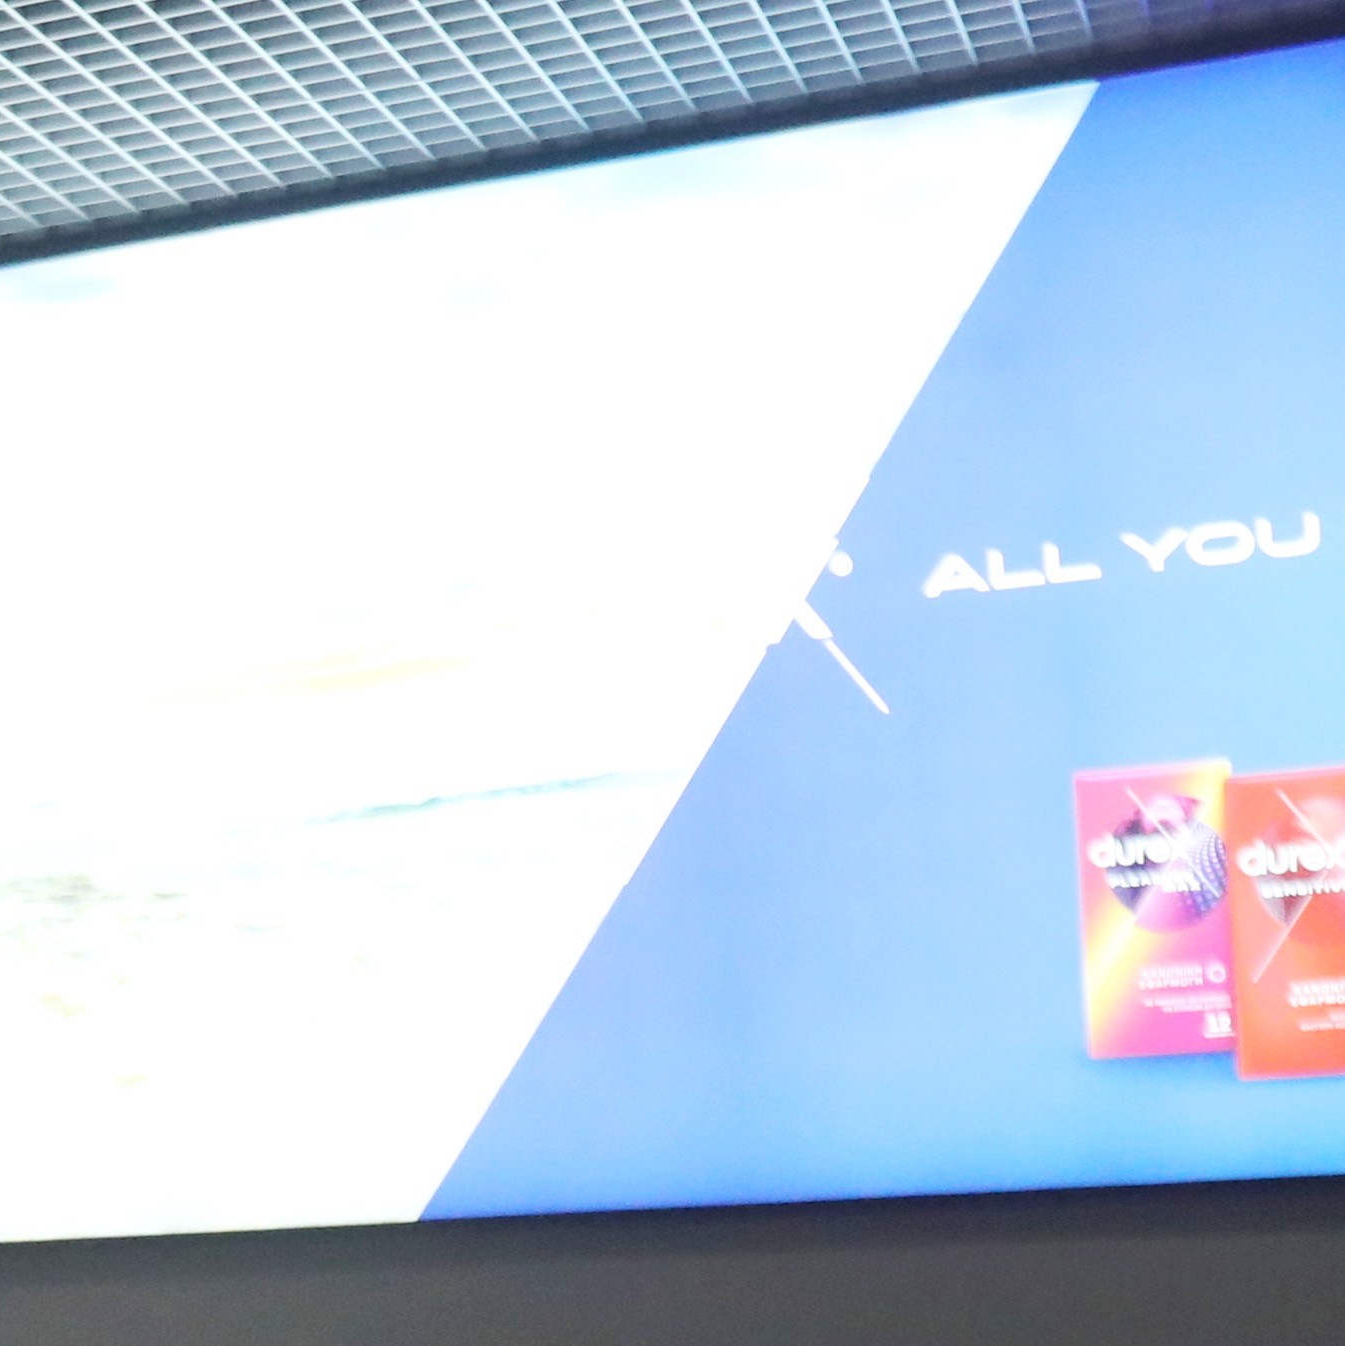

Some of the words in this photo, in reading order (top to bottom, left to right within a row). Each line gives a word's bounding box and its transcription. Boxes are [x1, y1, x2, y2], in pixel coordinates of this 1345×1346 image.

[922, 541, 1102, 598] ALL
[1118, 510, 1321, 572] YOU
[1087, 828, 1190, 868] durex
[1237, 838, 1345, 877] durex
[1260, 880, 1345, 899] SENSITIV
